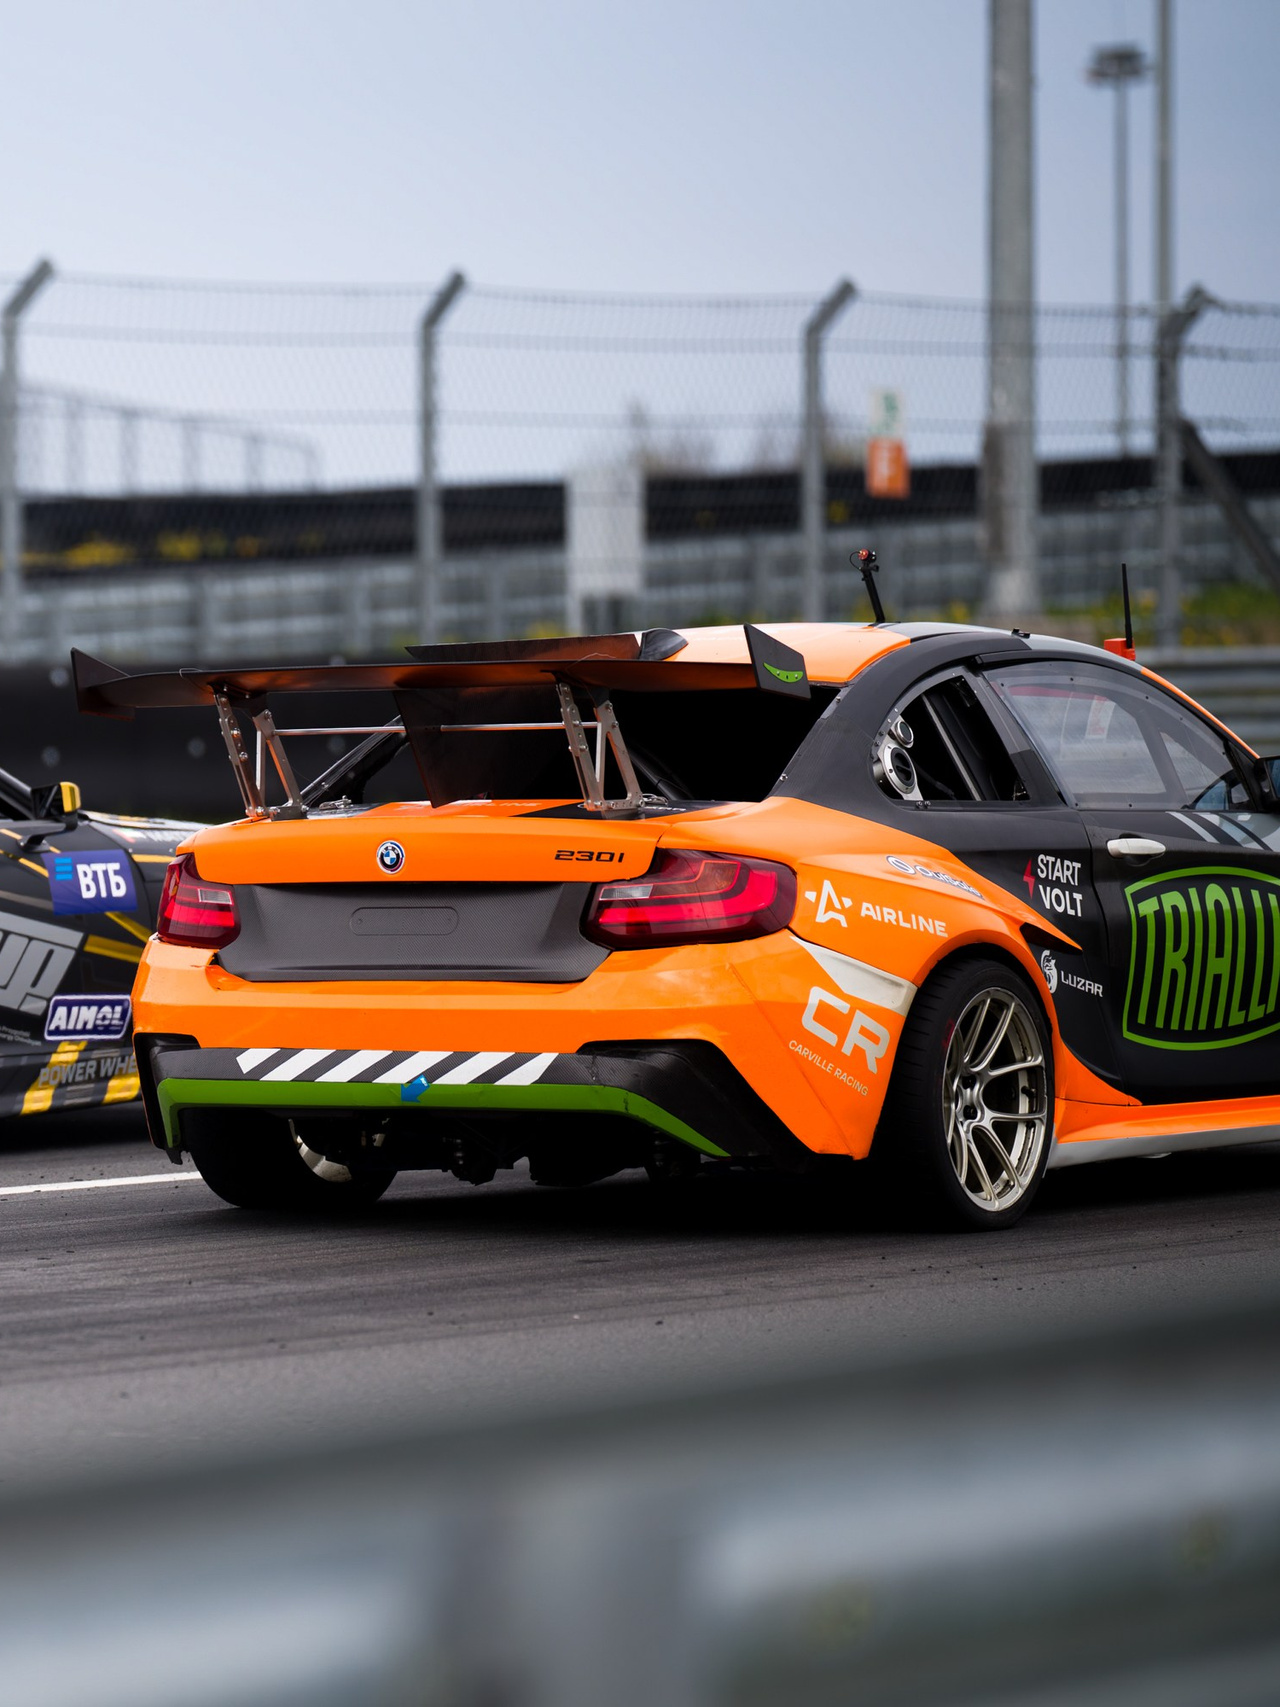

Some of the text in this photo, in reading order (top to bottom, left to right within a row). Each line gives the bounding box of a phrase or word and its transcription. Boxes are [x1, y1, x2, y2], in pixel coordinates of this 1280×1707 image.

[76, 862, 127, 899] ВТБ
[1037, 853, 1082, 886] START
[1038, 884, 1083, 917] VOLT
[860, 902, 949, 938] AIRLINE
[1060, 970, 1104, 998] LUZAR
[49, 1005, 124, 1031] AIMOL
[801, 986, 890, 1074] CR
[38, 1060, 97, 1087] POWER
[788, 1040, 869, 1096] CARVILLE RACING
